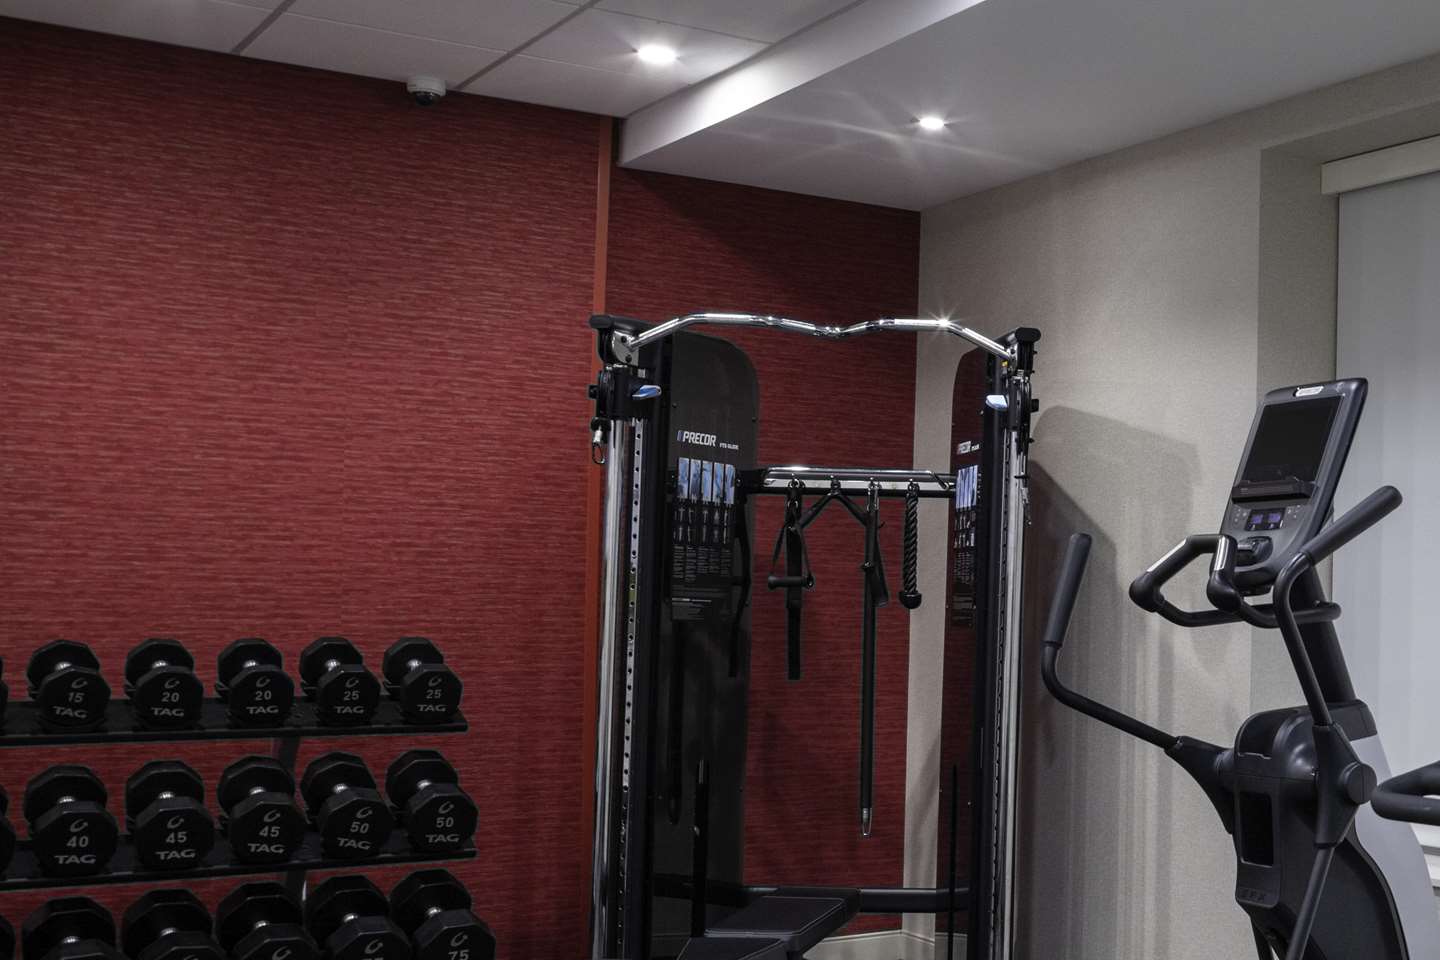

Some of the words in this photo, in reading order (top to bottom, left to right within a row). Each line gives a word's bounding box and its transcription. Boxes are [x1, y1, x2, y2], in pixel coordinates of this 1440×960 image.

[682, 431, 717, 447] PRECOR
[68, 691, 85, 703] 15
[161, 691, 180, 703] 20
[255, 689, 272, 701] 20
[343, 690, 361, 701] 25
[425, 688, 442, 700] 25
[52, 705, 87, 719] TAG
[151, 707, 185, 717] TAG
[246, 705, 279, 715] TAG
[334, 705, 365, 714] TAG
[416, 704, 446, 712] TAG
[349, 821, 370, 834] 50
[436, 816, 454, 829] 50
[165, 831, 187, 844] 45
[258, 825, 281, 838] 45
[66, 835, 89, 848] 40
[337, 837, 371, 851] TAG
[425, 833, 460, 843] TAG
[155, 848, 196, 861] TAG
[247, 843, 285, 854] TAG
[53, 854, 96, 865] TAG
